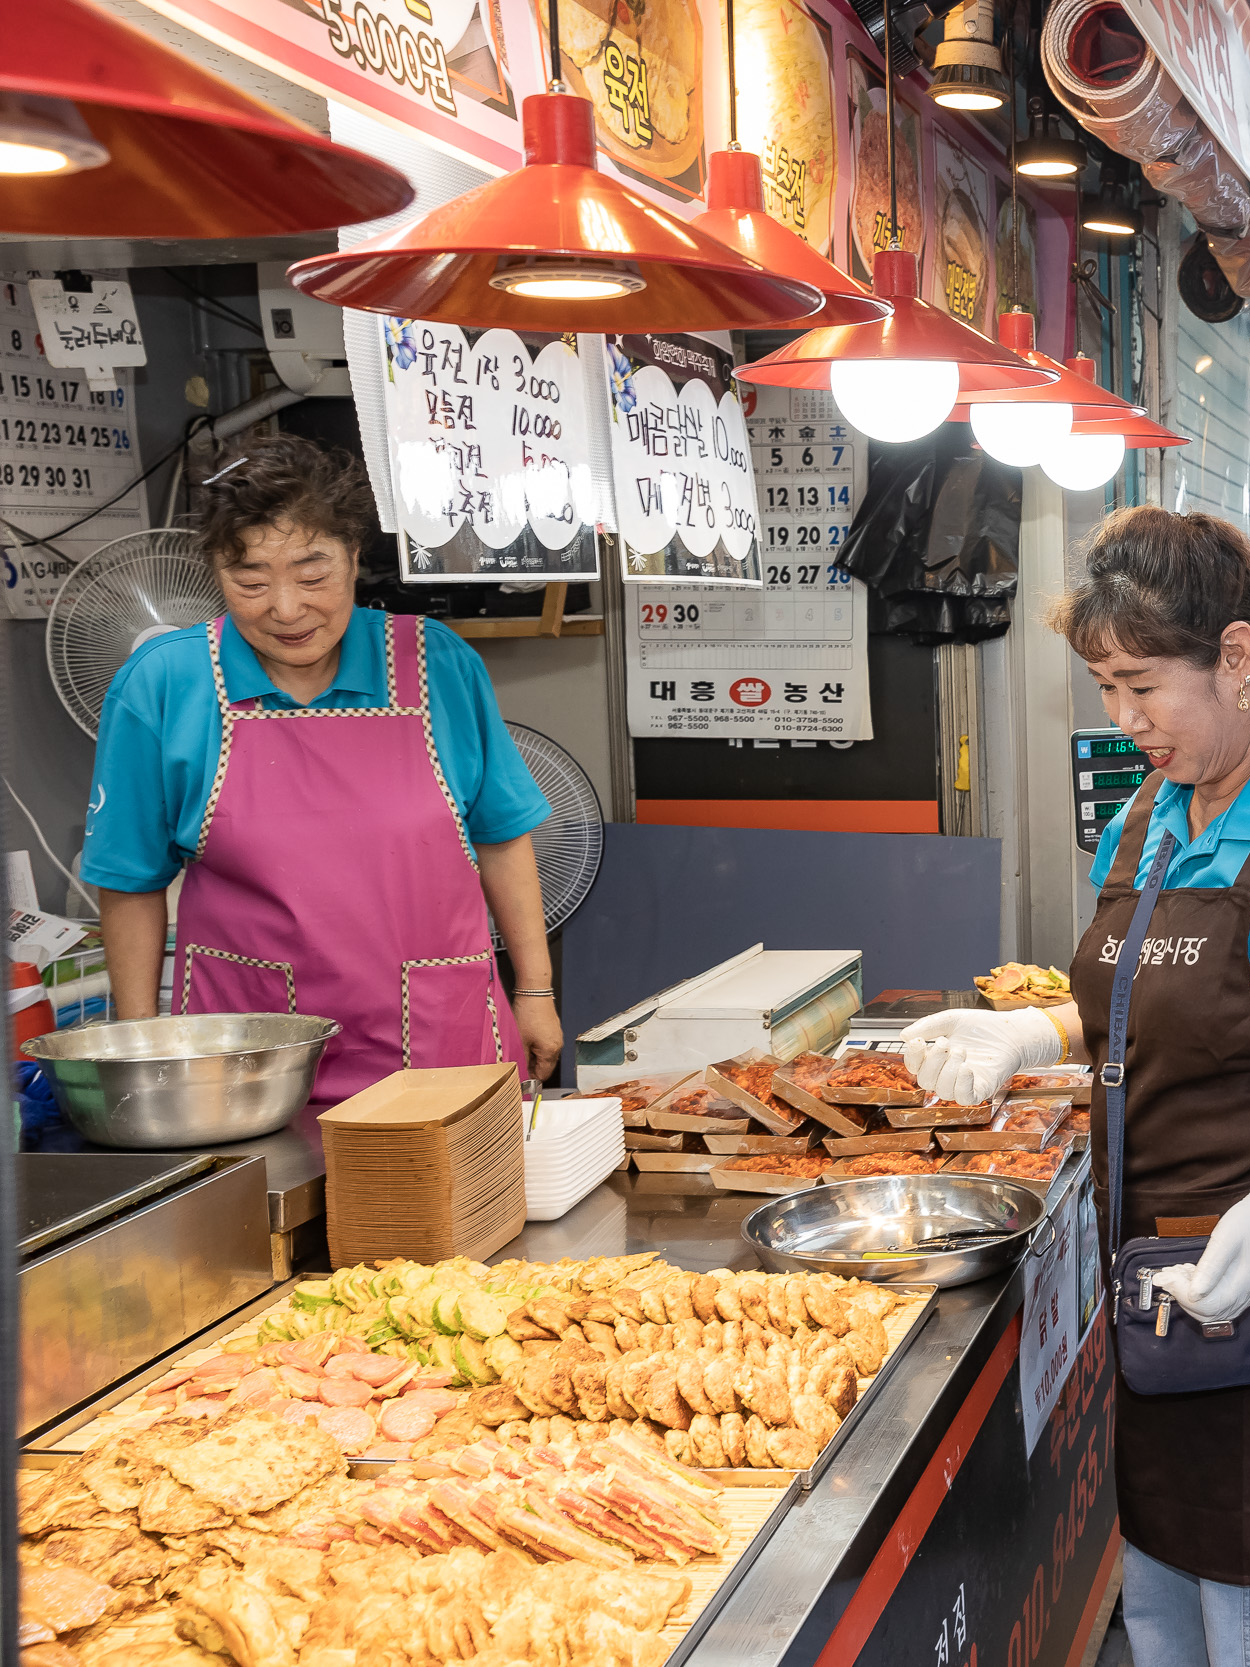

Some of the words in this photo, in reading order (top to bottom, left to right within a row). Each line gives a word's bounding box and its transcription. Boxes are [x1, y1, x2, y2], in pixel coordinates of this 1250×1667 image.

[322, 0, 458, 118] 5.000원
[603, 52, 653, 148] 육전
[761, 135, 806, 230] 부추전
[12, 330, 22, 350] 8
[418, 329, 467, 386] 육전
[513, 355, 560, 403] 3.000
[12, 375, 30, 397] 15
[37, 378, 55, 400] 16
[61, 381, 79, 402] 17
[512, 404, 562, 440] 10.000
[769, 427, 785, 439] 木
[798, 426, 816, 439] 金
[829, 425, 847, 438] 土
[15, 420, 37, 442] 22
[41, 423, 62, 444] 23
[66, 425, 86, 446] 24
[91, 427, 110, 448] 25
[112, 429, 130, 449] 26
[771, 448, 783, 466] 5
[802, 447, 814, 466] 6
[832, 447, 845, 466] 7
[19, 465, 40, 486] 29
[46, 467, 66, 488] 30
[72, 468, 92, 489] 31
[767, 488, 789, 507] 12
[798, 487, 819, 506] 13
[828, 486, 850, 505] 14
[768, 527, 789, 546] 19
[797, 526, 821, 545] 20
[767, 566, 791, 585] 26
[797, 566, 821, 584] 27
[641, 604, 668, 623] 29
[673, 604, 699, 623] 30
[736, 682, 765, 702] 쌀
[667, 722, 709, 730] 962-5500
[774, 724, 843, 732] 010-8724-6300
[714, 715, 755, 723] 968-5500
[774, 716, 844, 724] 010-3758-5500
[1131, 773, 1142, 785] 16
[1098, 935, 1208, 968] 화제일시장
